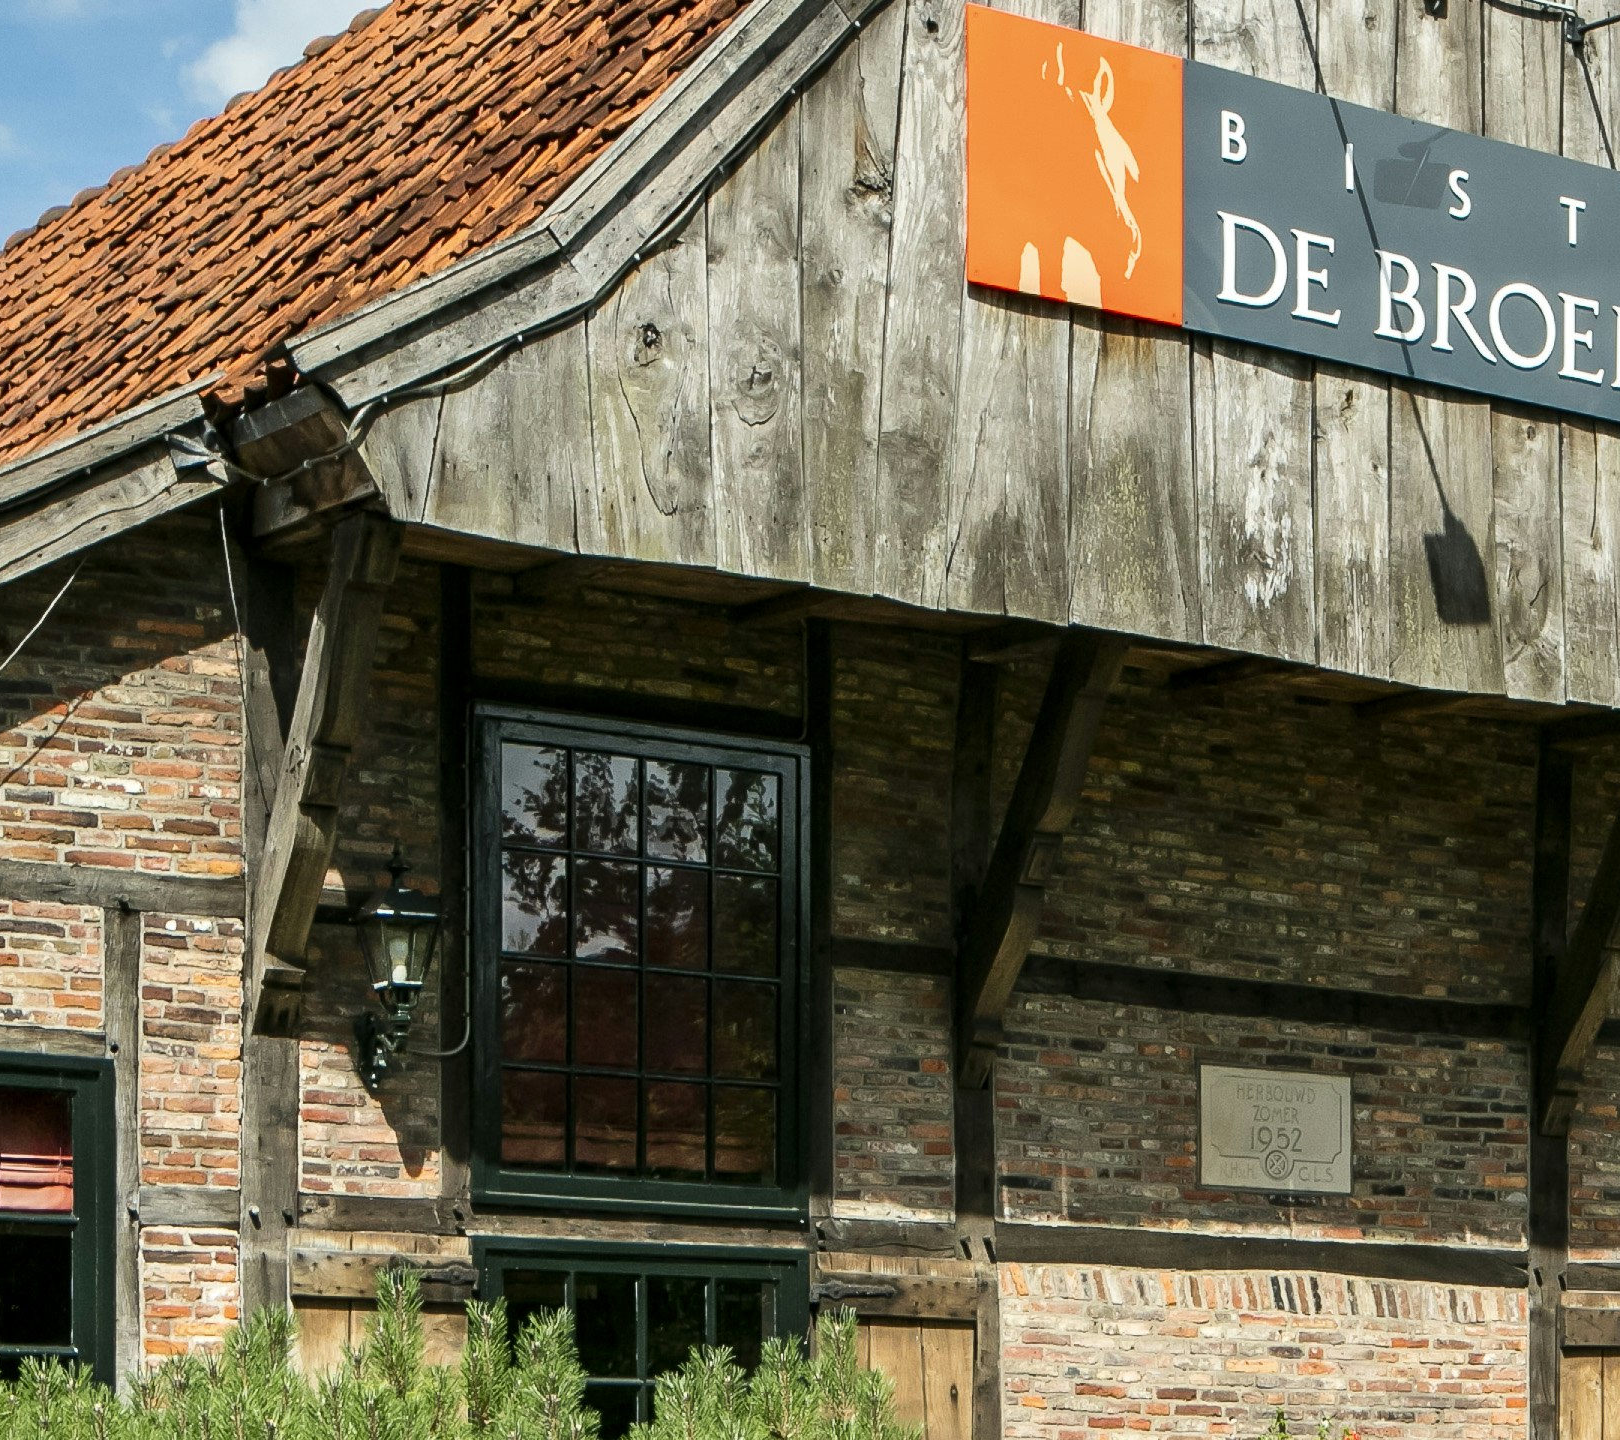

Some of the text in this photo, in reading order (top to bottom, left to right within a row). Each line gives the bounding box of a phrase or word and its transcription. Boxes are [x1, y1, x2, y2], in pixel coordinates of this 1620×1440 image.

[1215, 210, 1342, 326] DE
[1236, 1082, 1316, 1104] HERBOUWD
[1252, 1104, 1300, 1124] ZOMER
[1250, 1126, 1303, 1153] 1952
